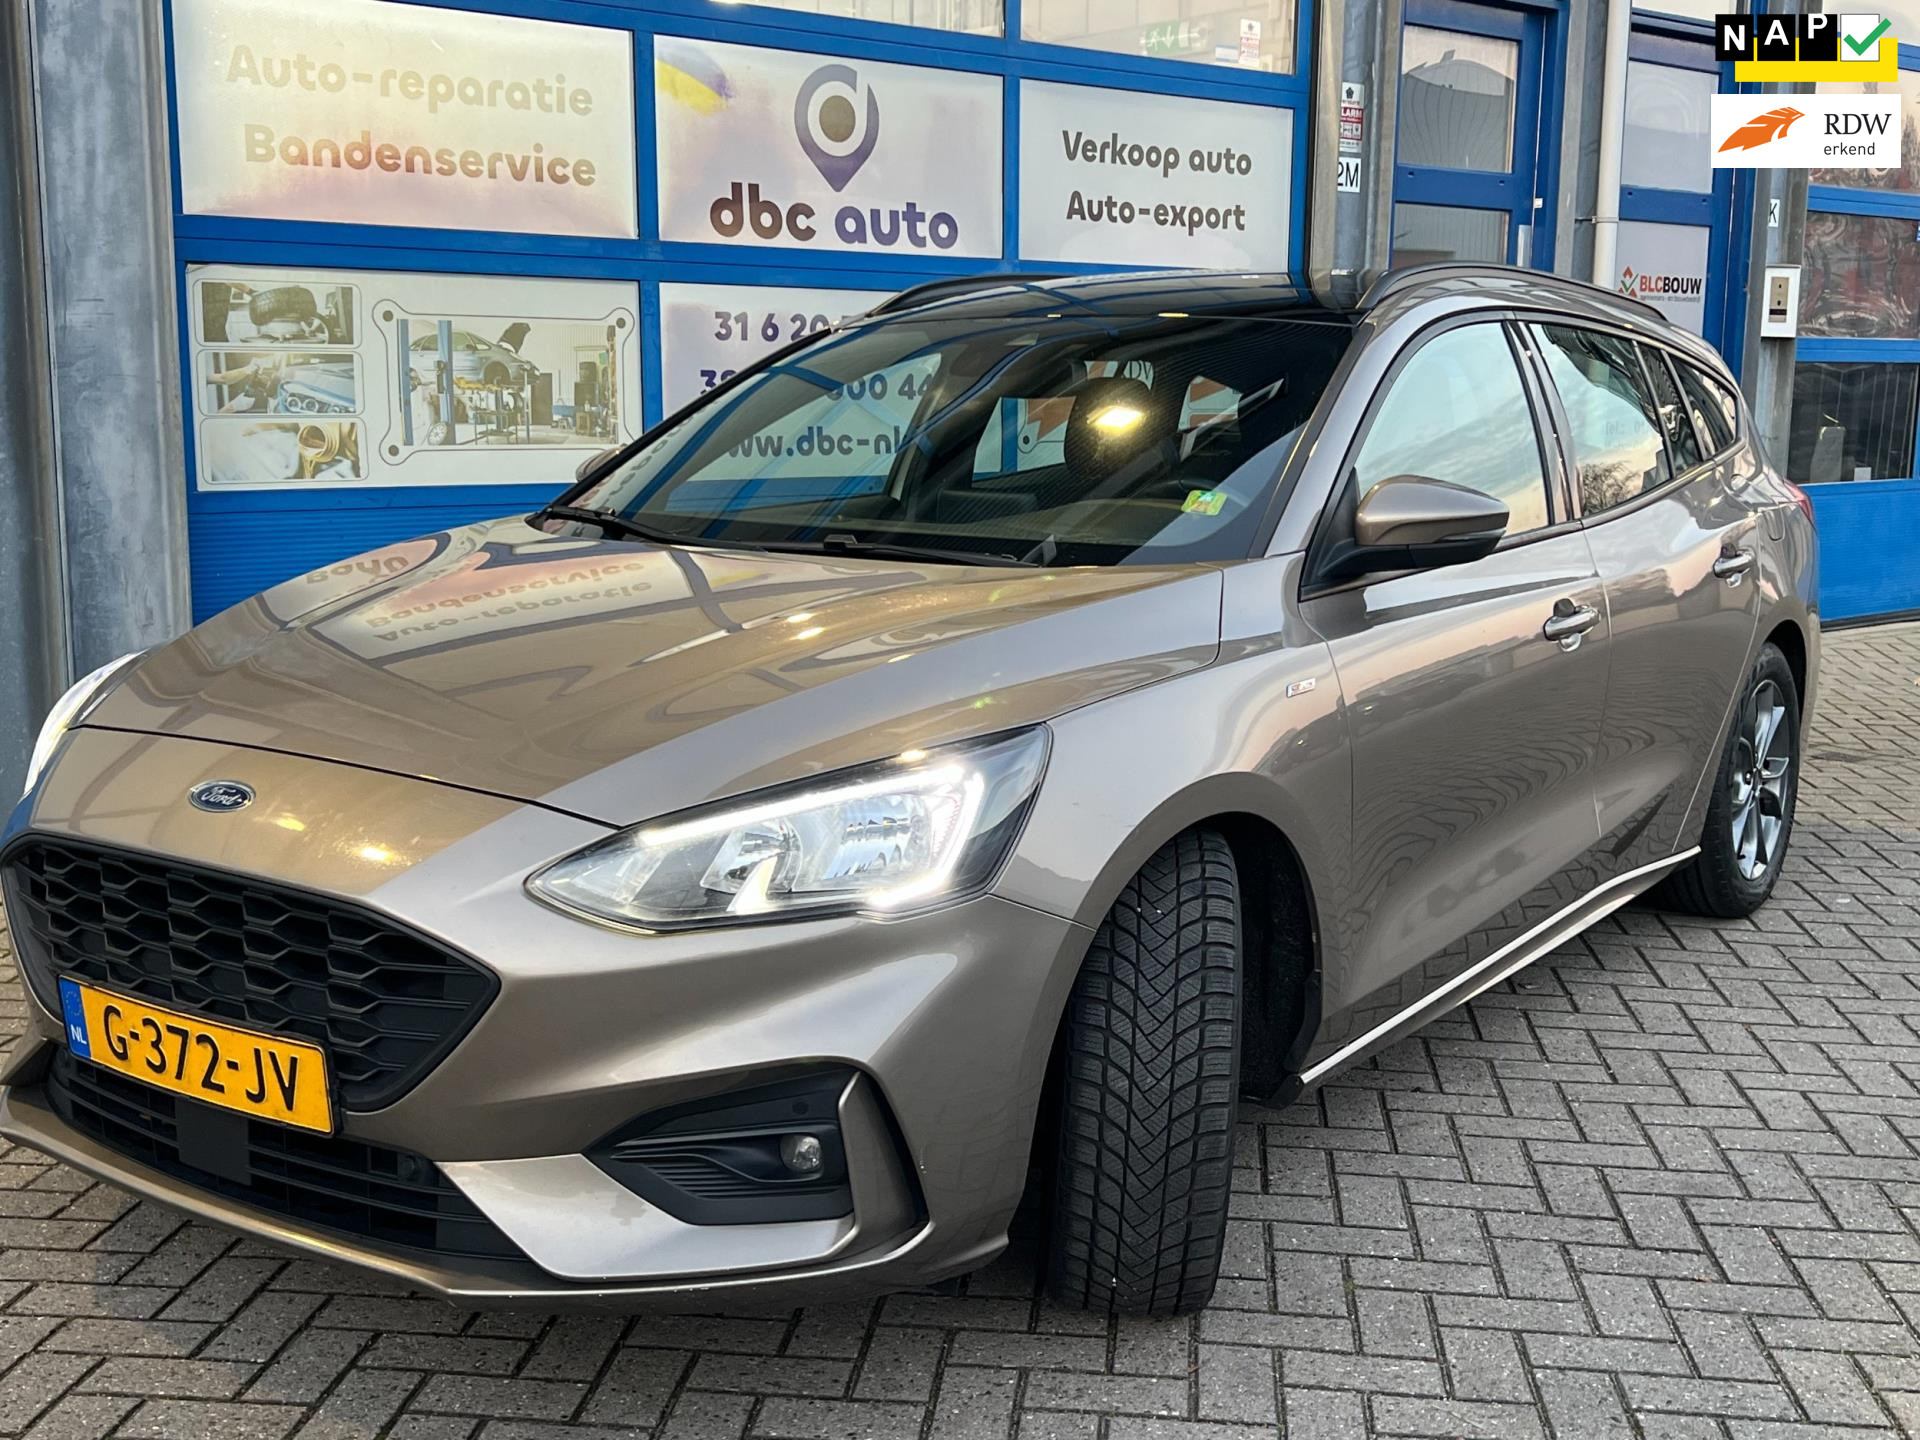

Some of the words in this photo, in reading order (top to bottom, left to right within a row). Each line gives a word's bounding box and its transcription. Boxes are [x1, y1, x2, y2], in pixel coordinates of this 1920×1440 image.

[226, 44, 593, 116] Auto-reparatie
[244, 124, 597, 186] Bandenservice
[1062, 130, 1180, 178] Verkoop
[1188, 147, 1252, 176] auto
[709, 181, 817, 242] dbc
[834, 202, 959, 250] auto
[1066, 190, 1246, 236] Auto-export
[1640, 275, 1702, 294] BLCBOUW
[715, 311, 748, 341] 31
[761, 313, 779, 342] 6
[201, 786, 242, 806] Ford
[71, 1026, 88, 1046] NL
[103, 1004, 299, 1112] G-372-JV
